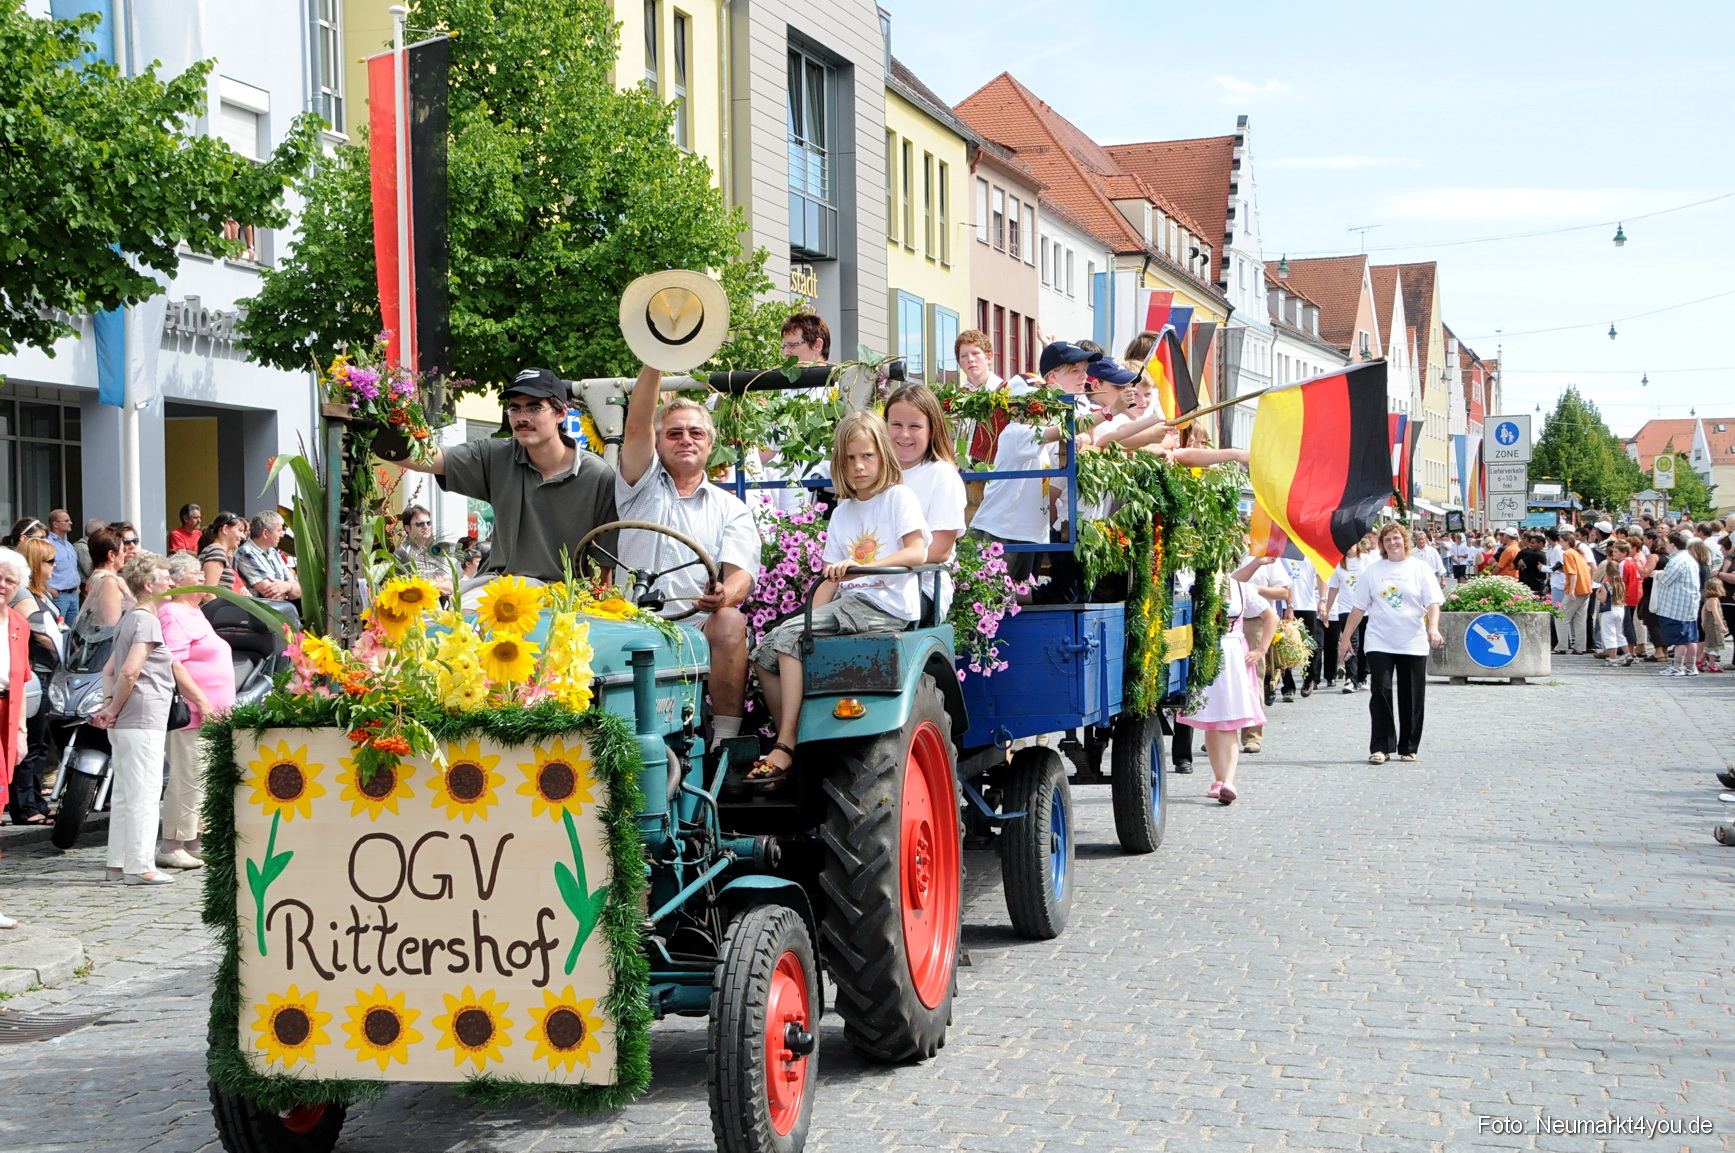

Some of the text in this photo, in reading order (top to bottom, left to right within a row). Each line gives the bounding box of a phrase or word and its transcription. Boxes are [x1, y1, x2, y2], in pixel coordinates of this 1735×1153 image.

[1490, 467, 1524, 475] Lieferverkehr
[1496, 450, 1519, 458] ZONE
[348, 831, 515, 903] OGV
[265, 898, 560, 988] Rittershof
